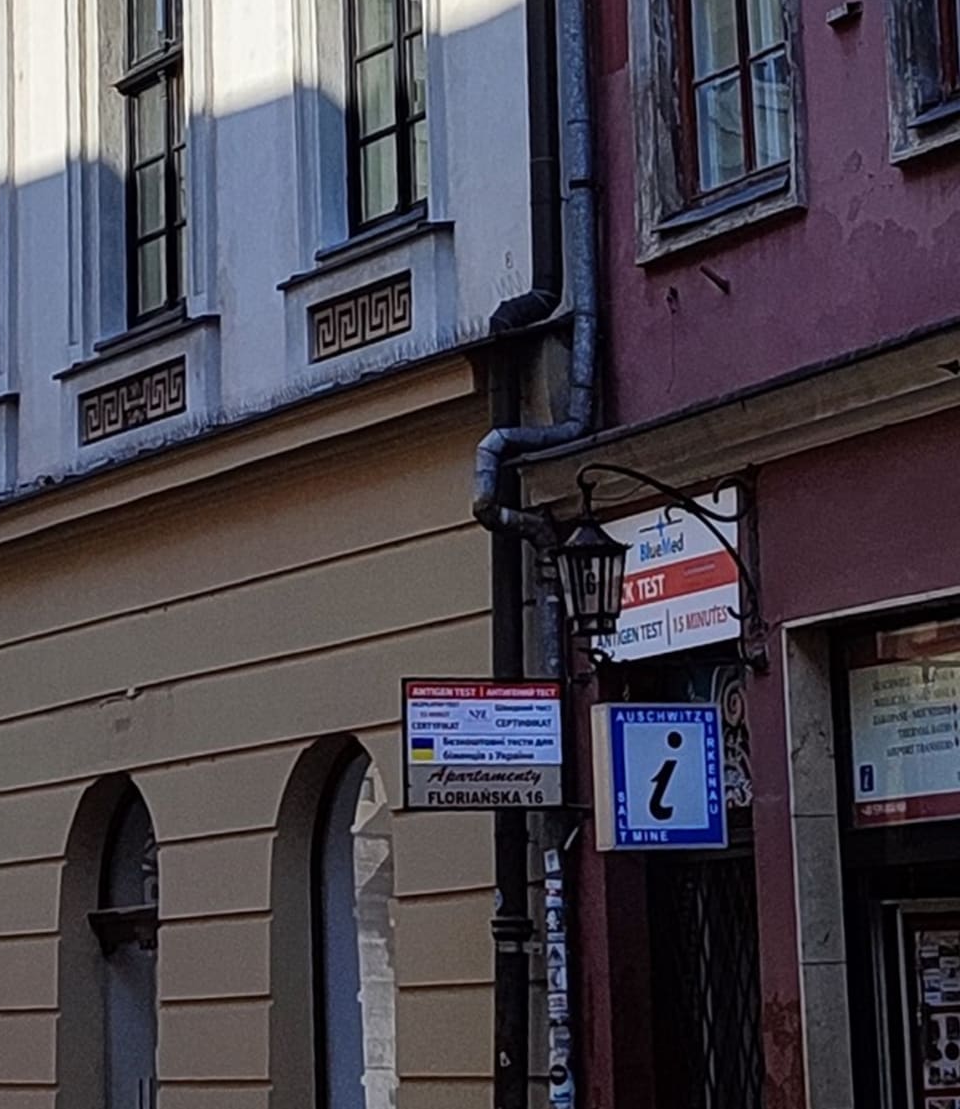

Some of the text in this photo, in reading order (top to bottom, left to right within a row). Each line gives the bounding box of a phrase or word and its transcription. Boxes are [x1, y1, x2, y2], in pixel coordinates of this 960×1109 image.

[640, 533, 683, 562] BlueMed
[637, 573, 665, 600] TEST
[640, 620, 663, 641] TEST
[673, 615, 684, 632] 15
[686, 605, 728, 630] MINUTES
[411, 687, 477, 697] ANTIGEN TEST
[616, 711, 702, 722] AUSCHWITZ
[427, 767, 542, 786] Apartamenty
[705, 711, 719, 815] BIRKENAU
[428, 788, 544, 804] FLORIAŃSKA 16
[617, 791, 669, 841] SALT MINE
